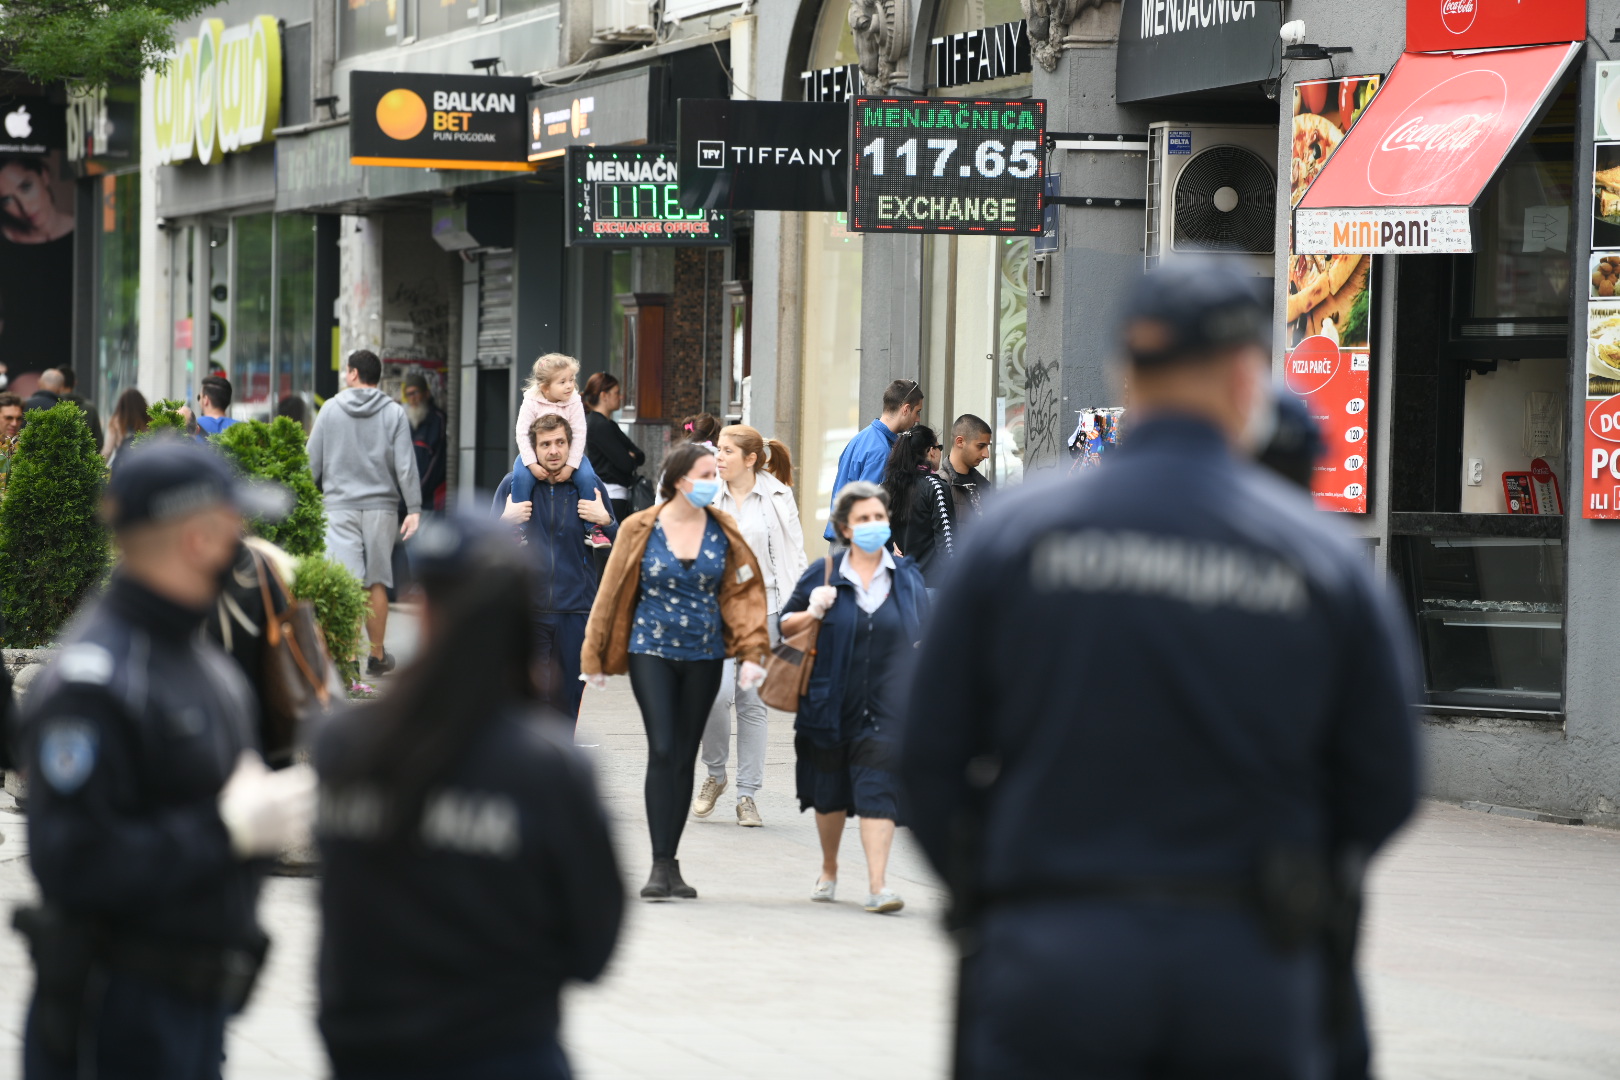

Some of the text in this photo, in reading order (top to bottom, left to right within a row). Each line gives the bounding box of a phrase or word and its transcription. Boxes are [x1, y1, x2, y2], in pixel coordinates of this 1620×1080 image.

[932, 19, 1022, 88] TIFFANY
[433, 90, 515, 113] BALKAN
[433, 111, 472, 131] BET
[864, 103, 1035, 130] MENJAČNICA
[433, 131, 496, 143] PUN POGODAK
[702, 149, 721, 160] TFY
[731, 146, 842, 166] TIFFANY
[863, 137, 1038, 178] 117.65
[583, 183, 592, 221] ULTRA
[613, 184, 704, 220] 117.6
[878, 195, 1016, 222] EXCHANGE
[593, 221, 709, 234] EXCHANGE OFFICE
[1292, 357, 1332, 374] PIZZA PARČE
[1350, 401, 1360, 412] 120
[1349, 429, 1360, 440] 120
[1348, 458, 1359, 469] 100
[1348, 485, 1359, 496] 120
[1590, 493, 1609, 510] ILI
